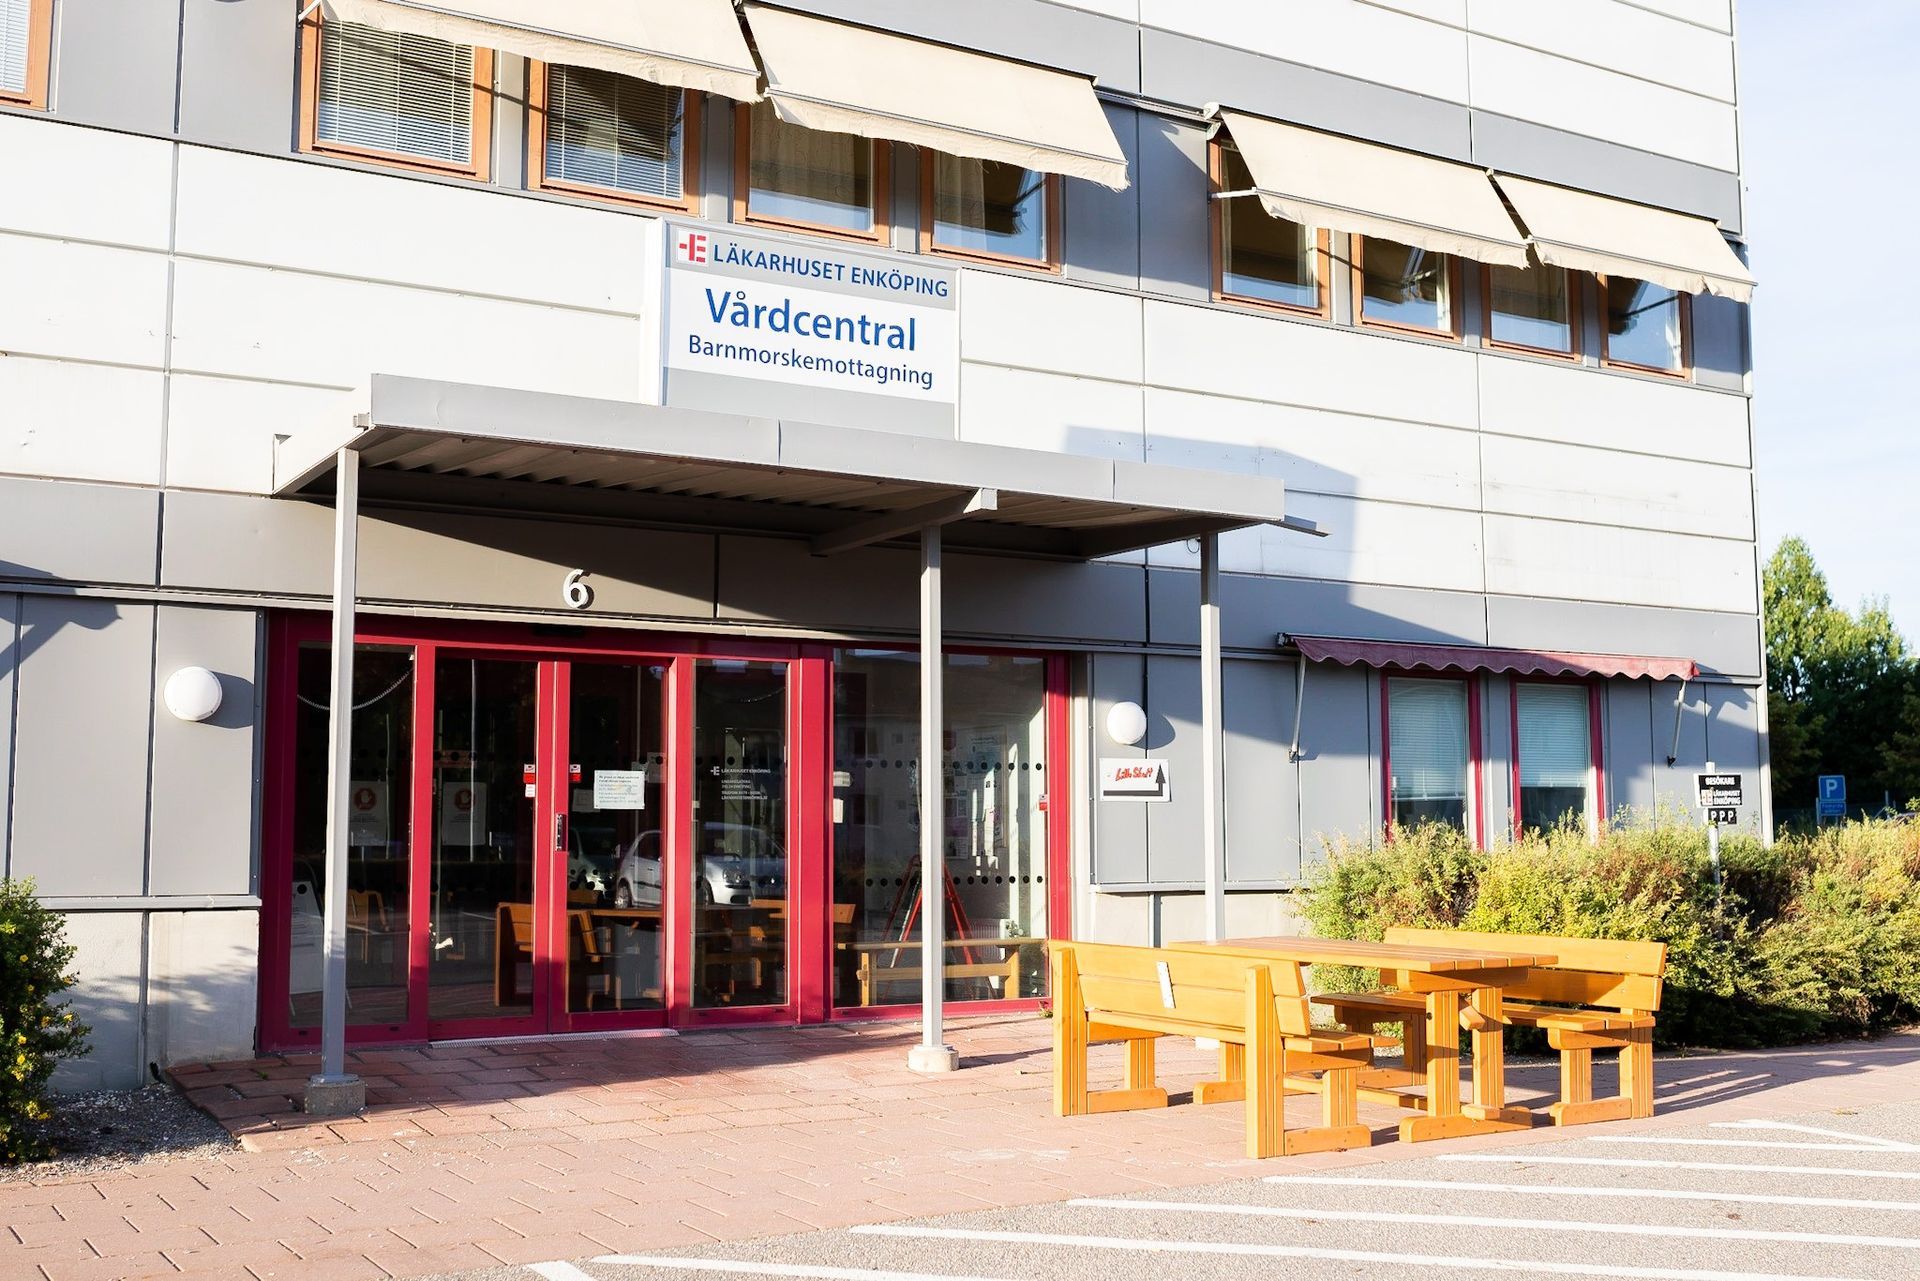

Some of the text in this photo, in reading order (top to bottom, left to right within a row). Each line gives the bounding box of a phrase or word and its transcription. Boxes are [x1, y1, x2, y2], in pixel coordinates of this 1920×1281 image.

[713, 243, 845, 281] LÄKARHUSET
[851, 266, 948, 298] ENKÖPING
[705, 288, 915, 351] Vårdcentral
[689, 335, 933, 390] Barnmorskemottagning
[563, 568, 588, 608] 6
[1826, 779, 1838, 798] P
